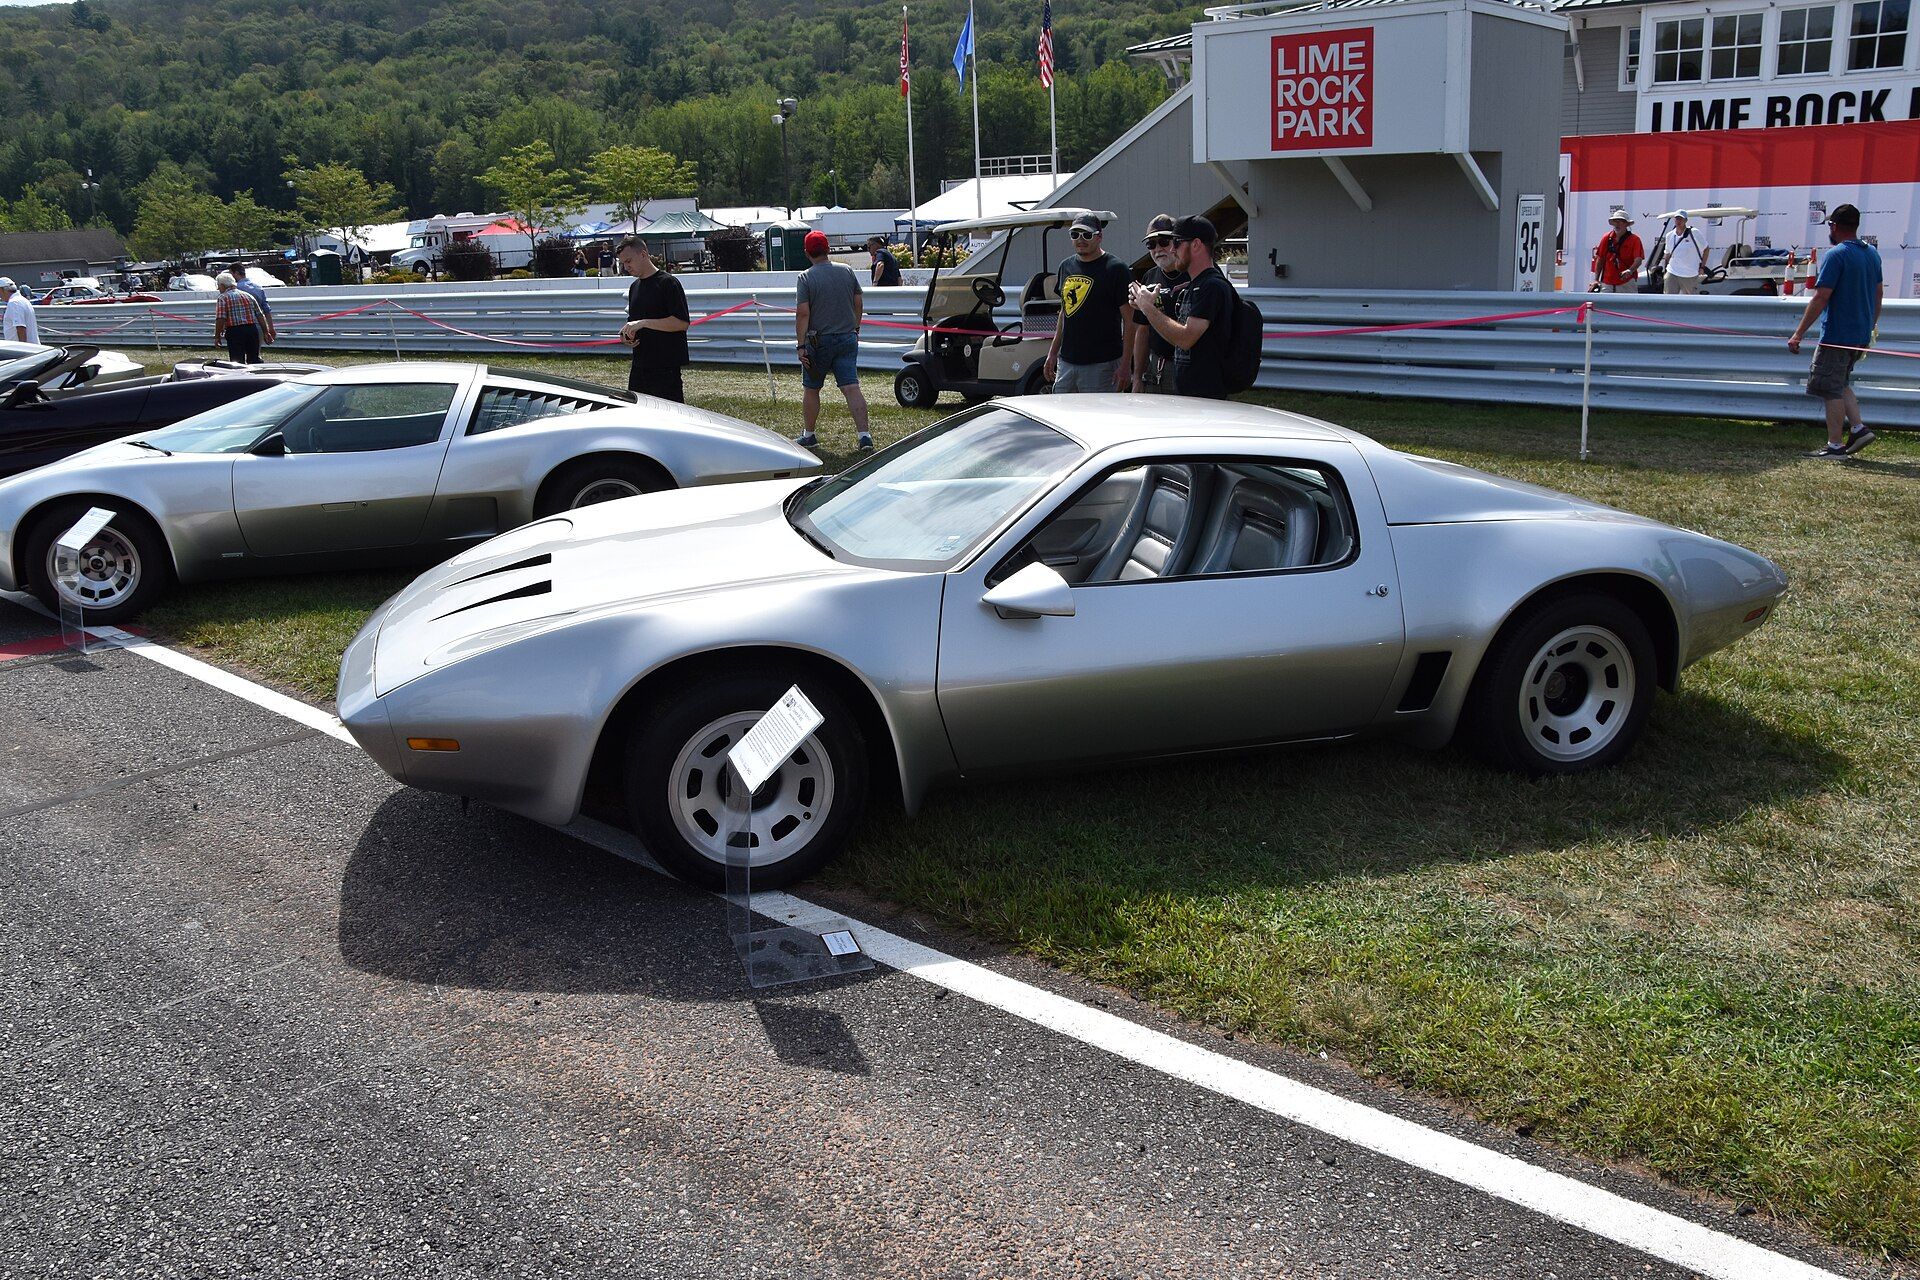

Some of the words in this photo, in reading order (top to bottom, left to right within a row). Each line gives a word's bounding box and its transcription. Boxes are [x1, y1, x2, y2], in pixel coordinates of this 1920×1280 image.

[1277, 41, 1366, 76] LIME
[1277, 73, 1366, 107] ROCK
[1277, 106, 1366, 139] PARK
[1651, 97, 1751, 132] LIME
[1765, 88, 1892, 128] ROCK
[1519, 221, 1540, 274] 35
